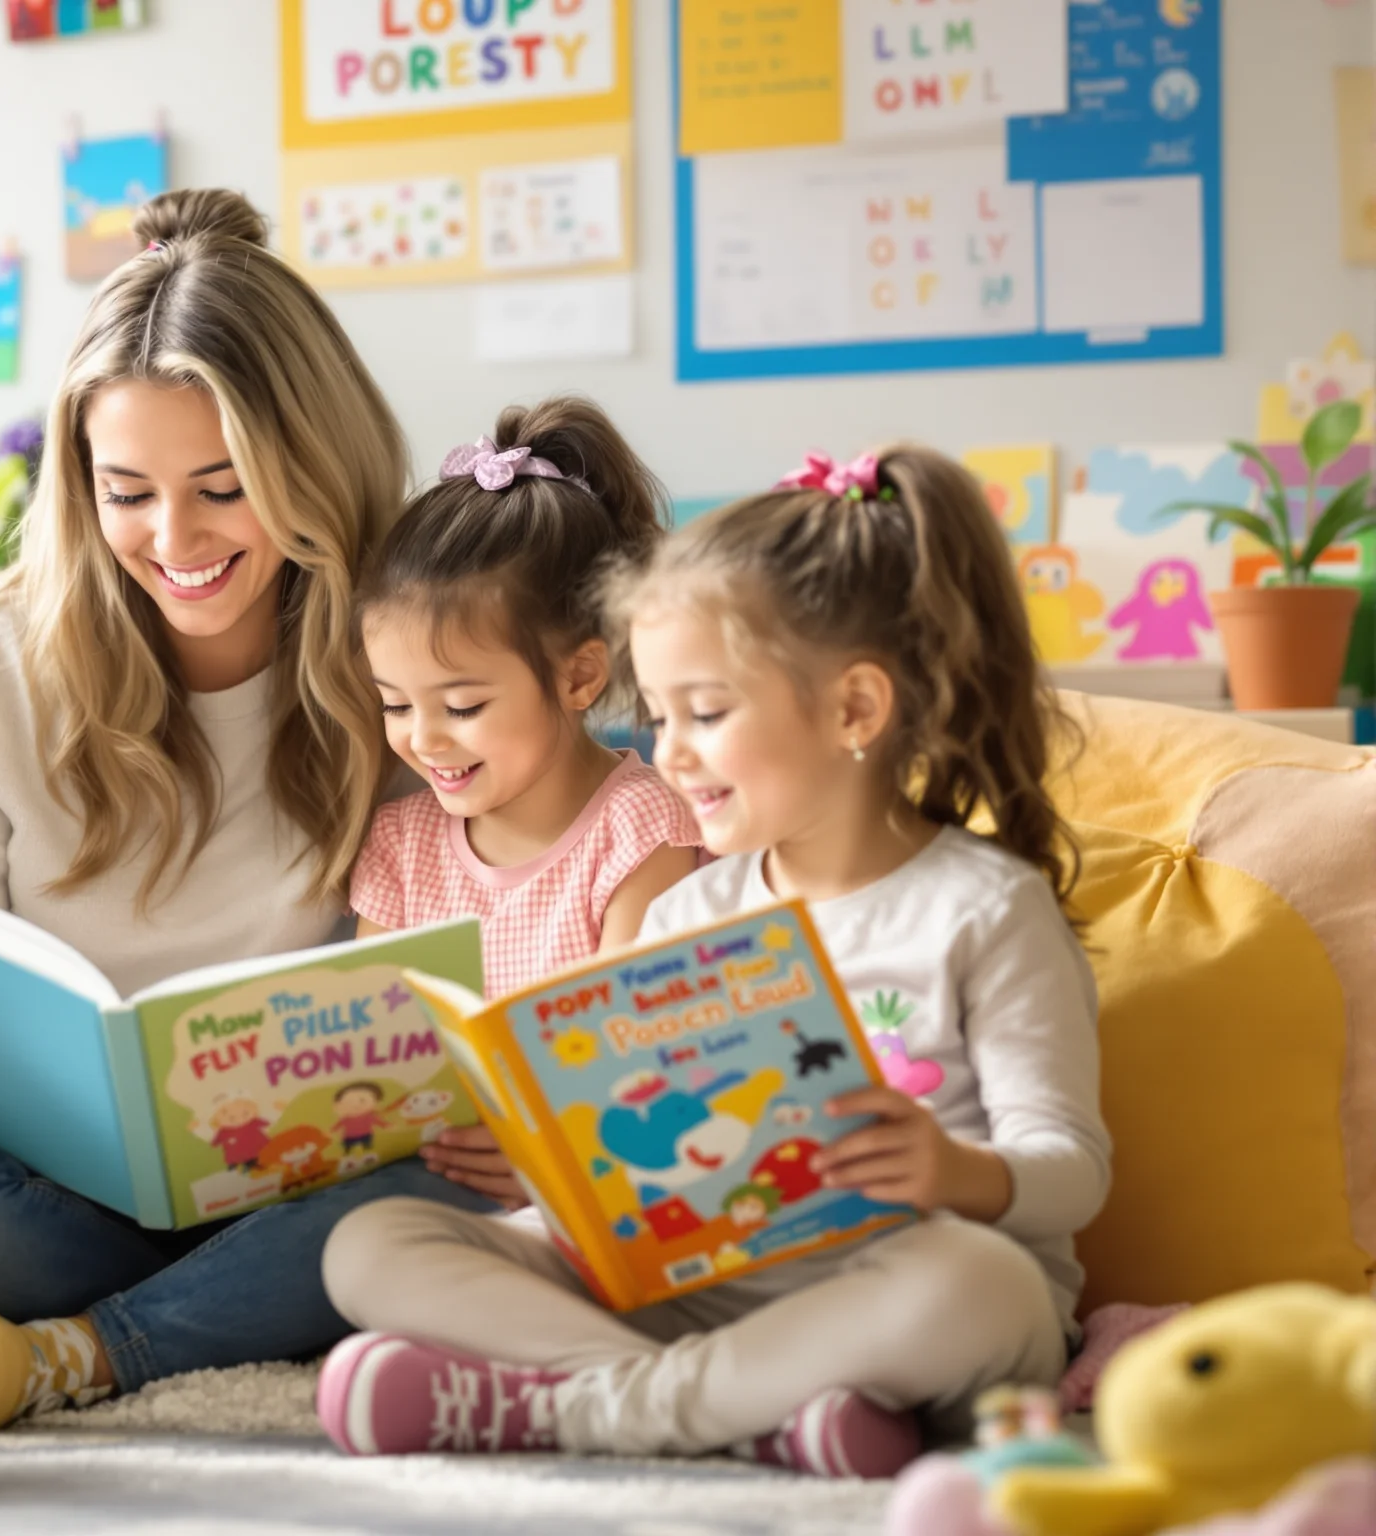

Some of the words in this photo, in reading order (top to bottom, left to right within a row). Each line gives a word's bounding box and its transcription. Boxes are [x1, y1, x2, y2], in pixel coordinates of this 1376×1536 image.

[336, 33, 587, 97] PORESTY
[266, 990, 313, 1015] The
[265, 1040, 353, 1087] PON
[365, 1030, 441, 1067] LIM
